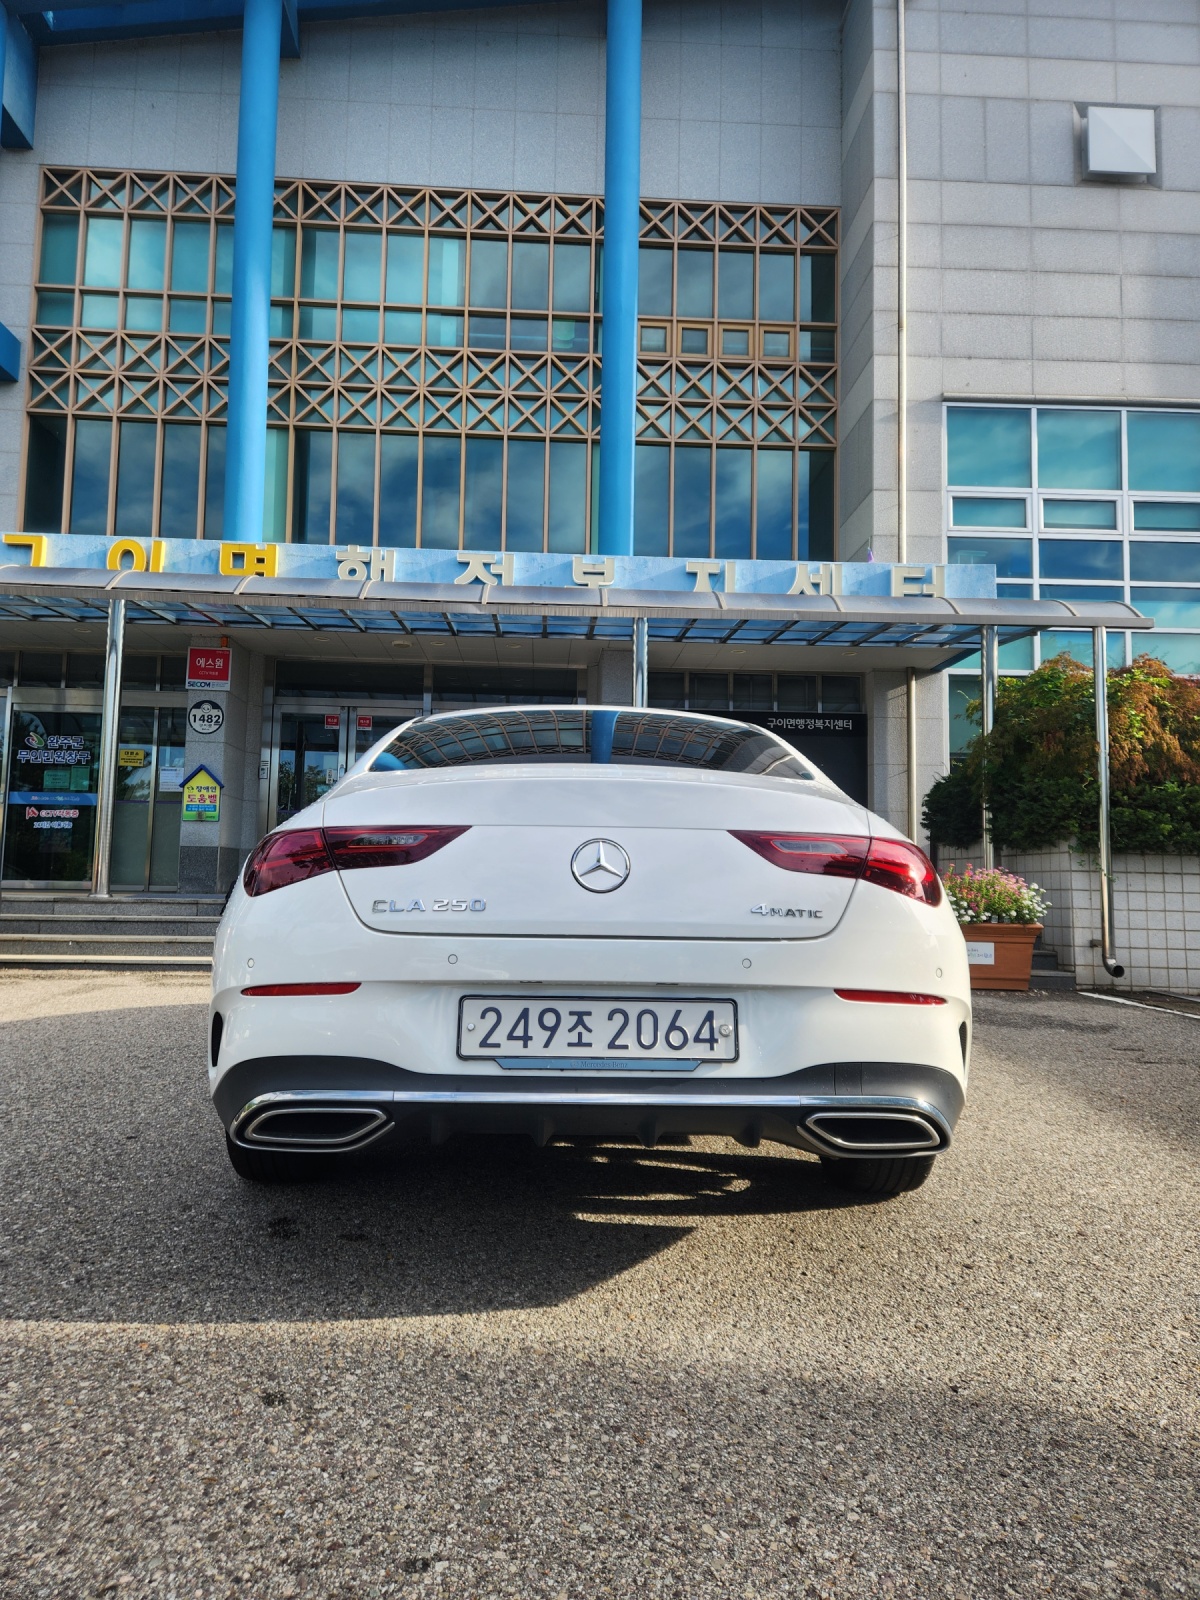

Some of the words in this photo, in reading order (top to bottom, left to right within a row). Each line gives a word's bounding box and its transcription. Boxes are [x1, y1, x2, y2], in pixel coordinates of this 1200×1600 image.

[195, 657, 224, 669] 에스원
[192, 714, 221, 723] 1482
[47, 735, 84, 749] 완주군
[17, 749, 91, 764] 무인민원창구
[195, 785, 217, 793] 장애인
[186, 793, 217, 804] 도움벨
[371, 899, 426, 913] CLA
[432, 898, 487, 912] 250
[750, 903, 824, 919] 4MATIC
[607, 1008, 719, 1051] 2064
